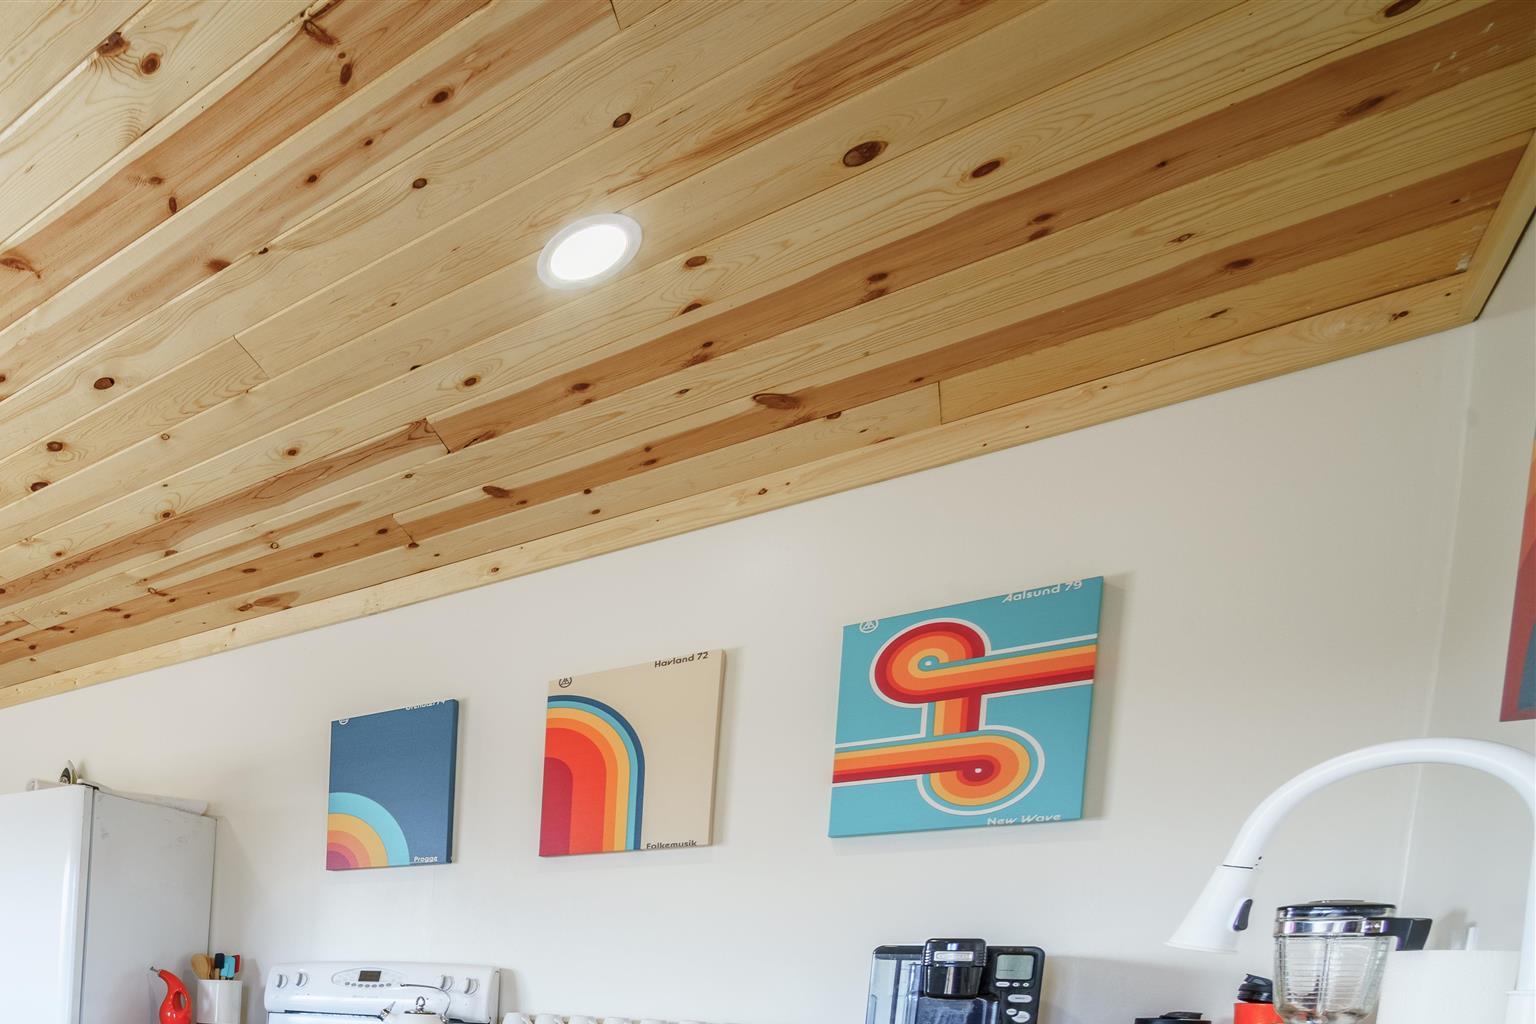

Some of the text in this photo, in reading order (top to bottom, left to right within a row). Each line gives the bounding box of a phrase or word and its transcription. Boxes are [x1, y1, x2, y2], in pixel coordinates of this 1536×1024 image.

[1001, 579, 1082, 603] Aalsund 79
[654, 651, 709, 668] Havland 72
[987, 814, 1062, 826] New Wave
[646, 840, 697, 850] Folkemusik
